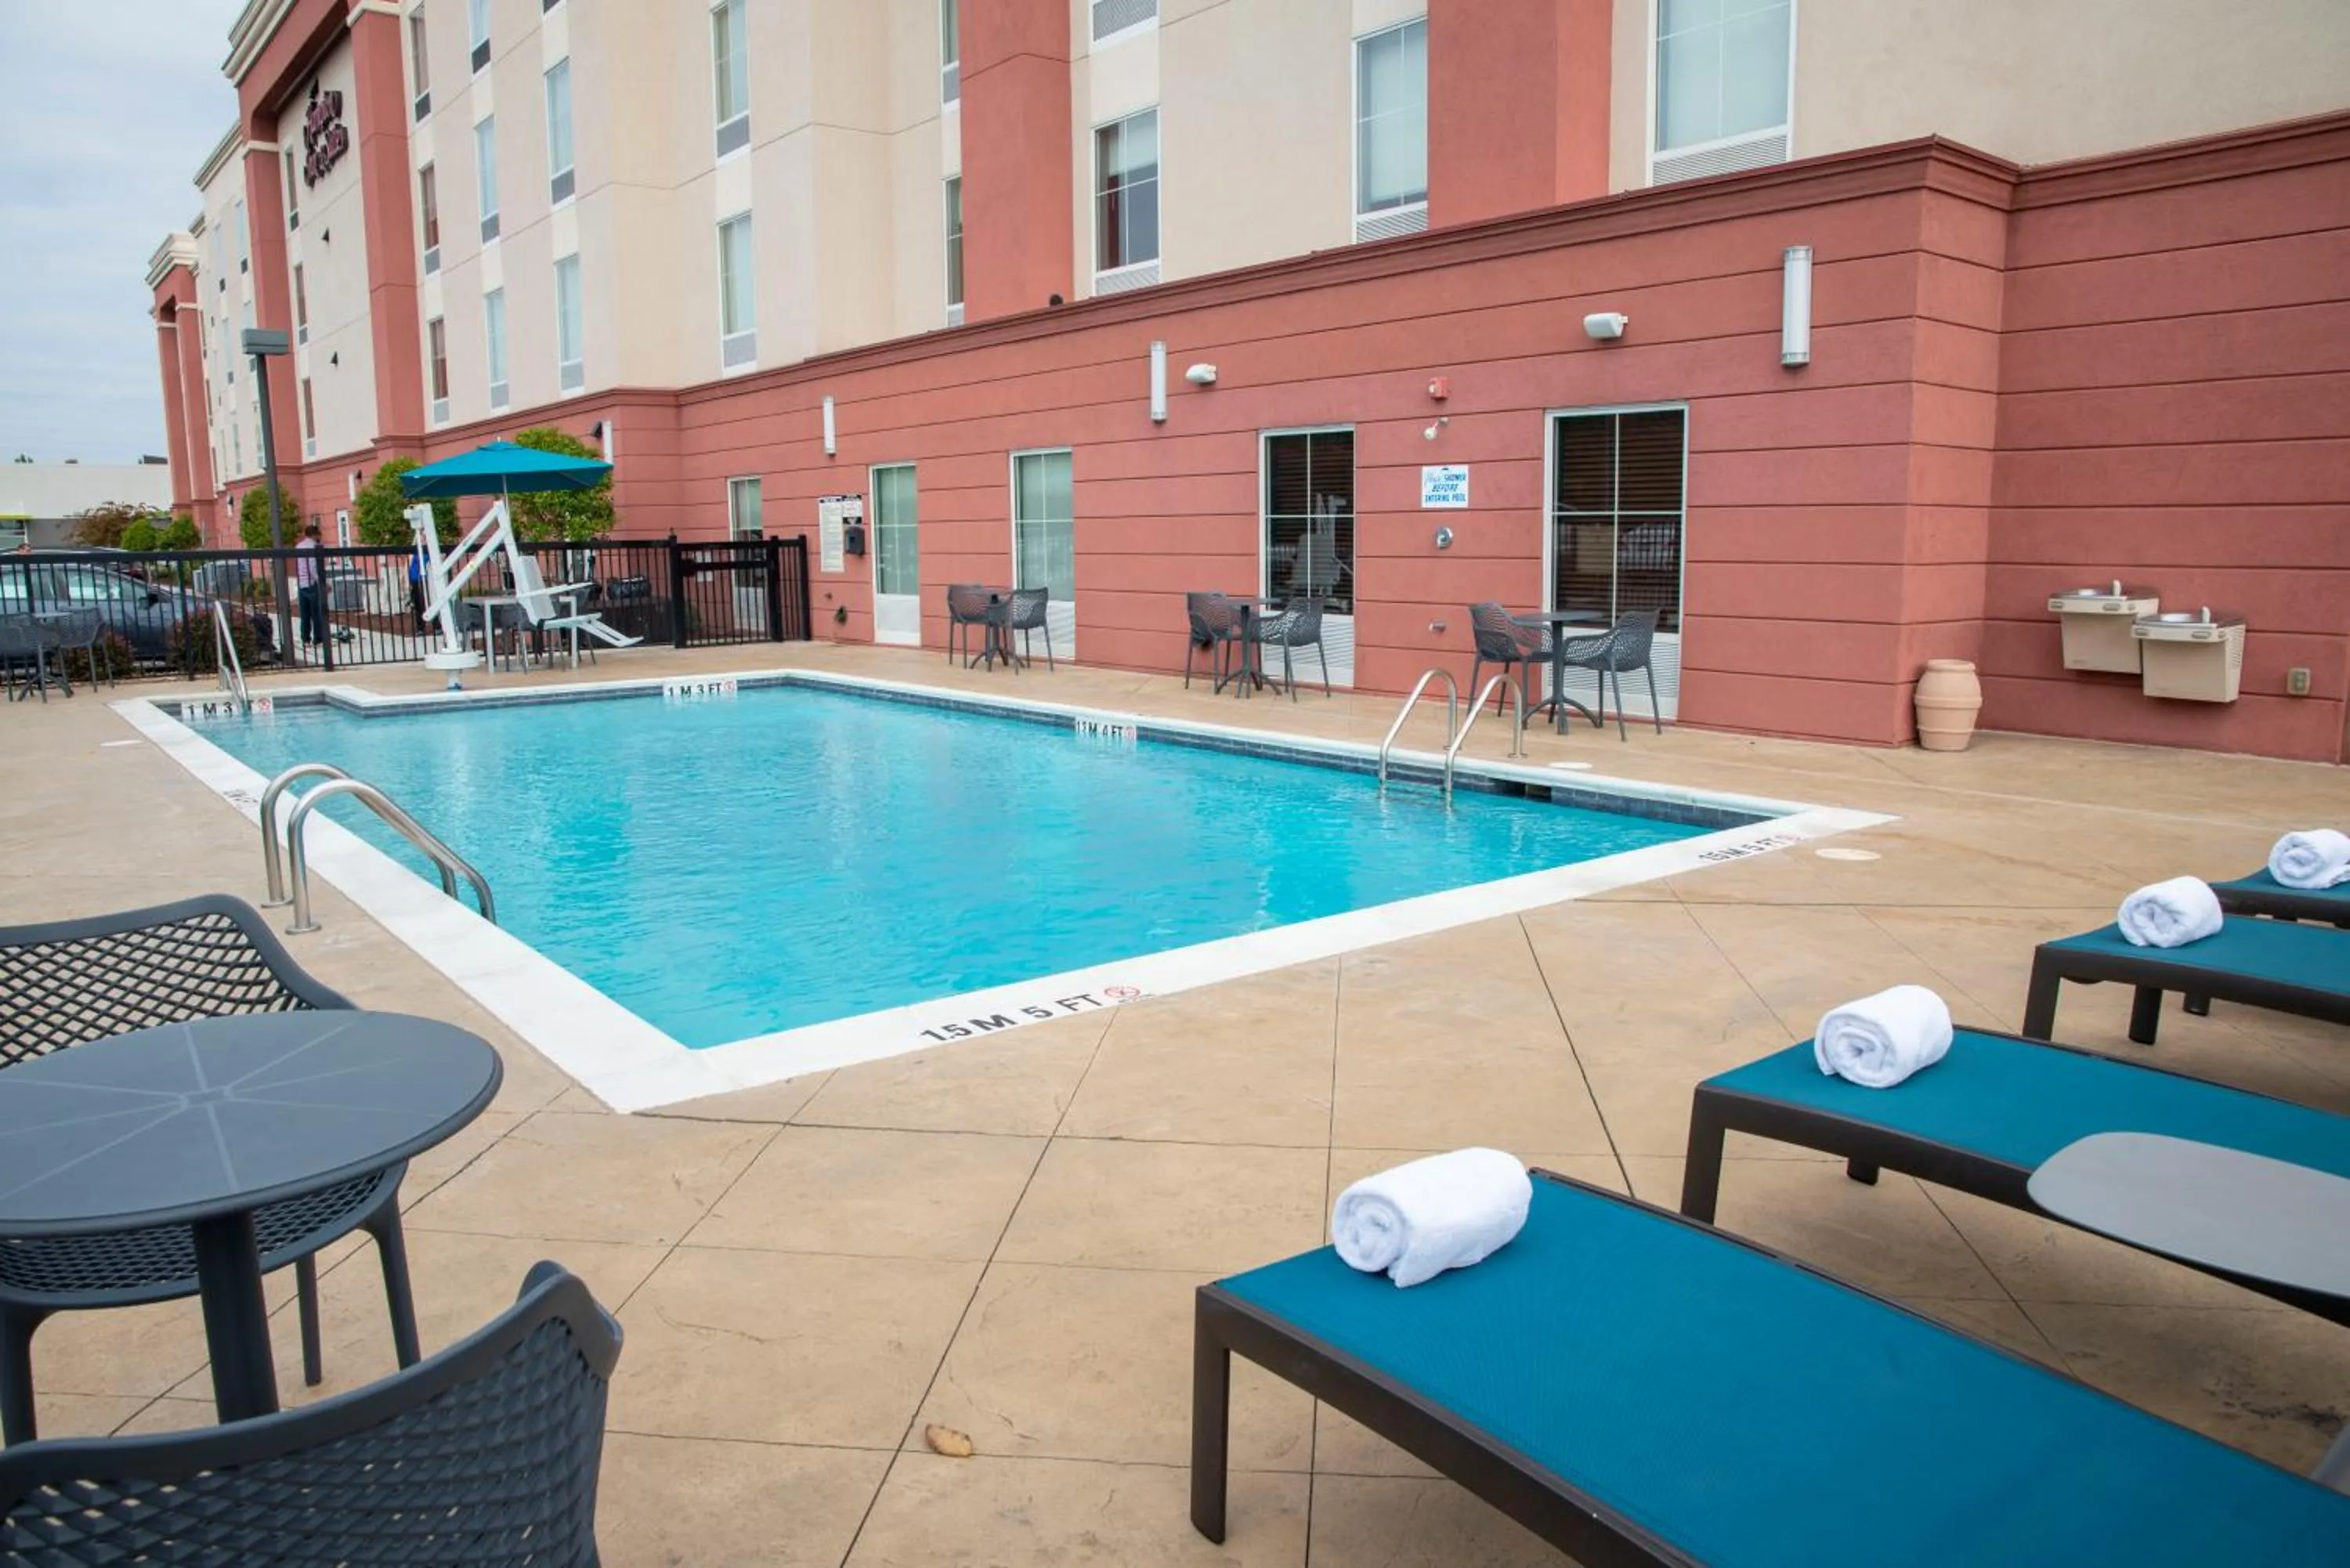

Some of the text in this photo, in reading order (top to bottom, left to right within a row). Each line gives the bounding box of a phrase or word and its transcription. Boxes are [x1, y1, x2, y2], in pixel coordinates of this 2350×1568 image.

[1432, 483, 1459, 492] BEFORE
[1452, 493, 1466, 502] POOL
[708, 682, 721, 695] FT
[203, 703, 217, 716] M
[1112, 725, 1123, 737] FT
[1021, 1006, 1053, 1018] 5
[1055, 993, 1103, 1012] FT
